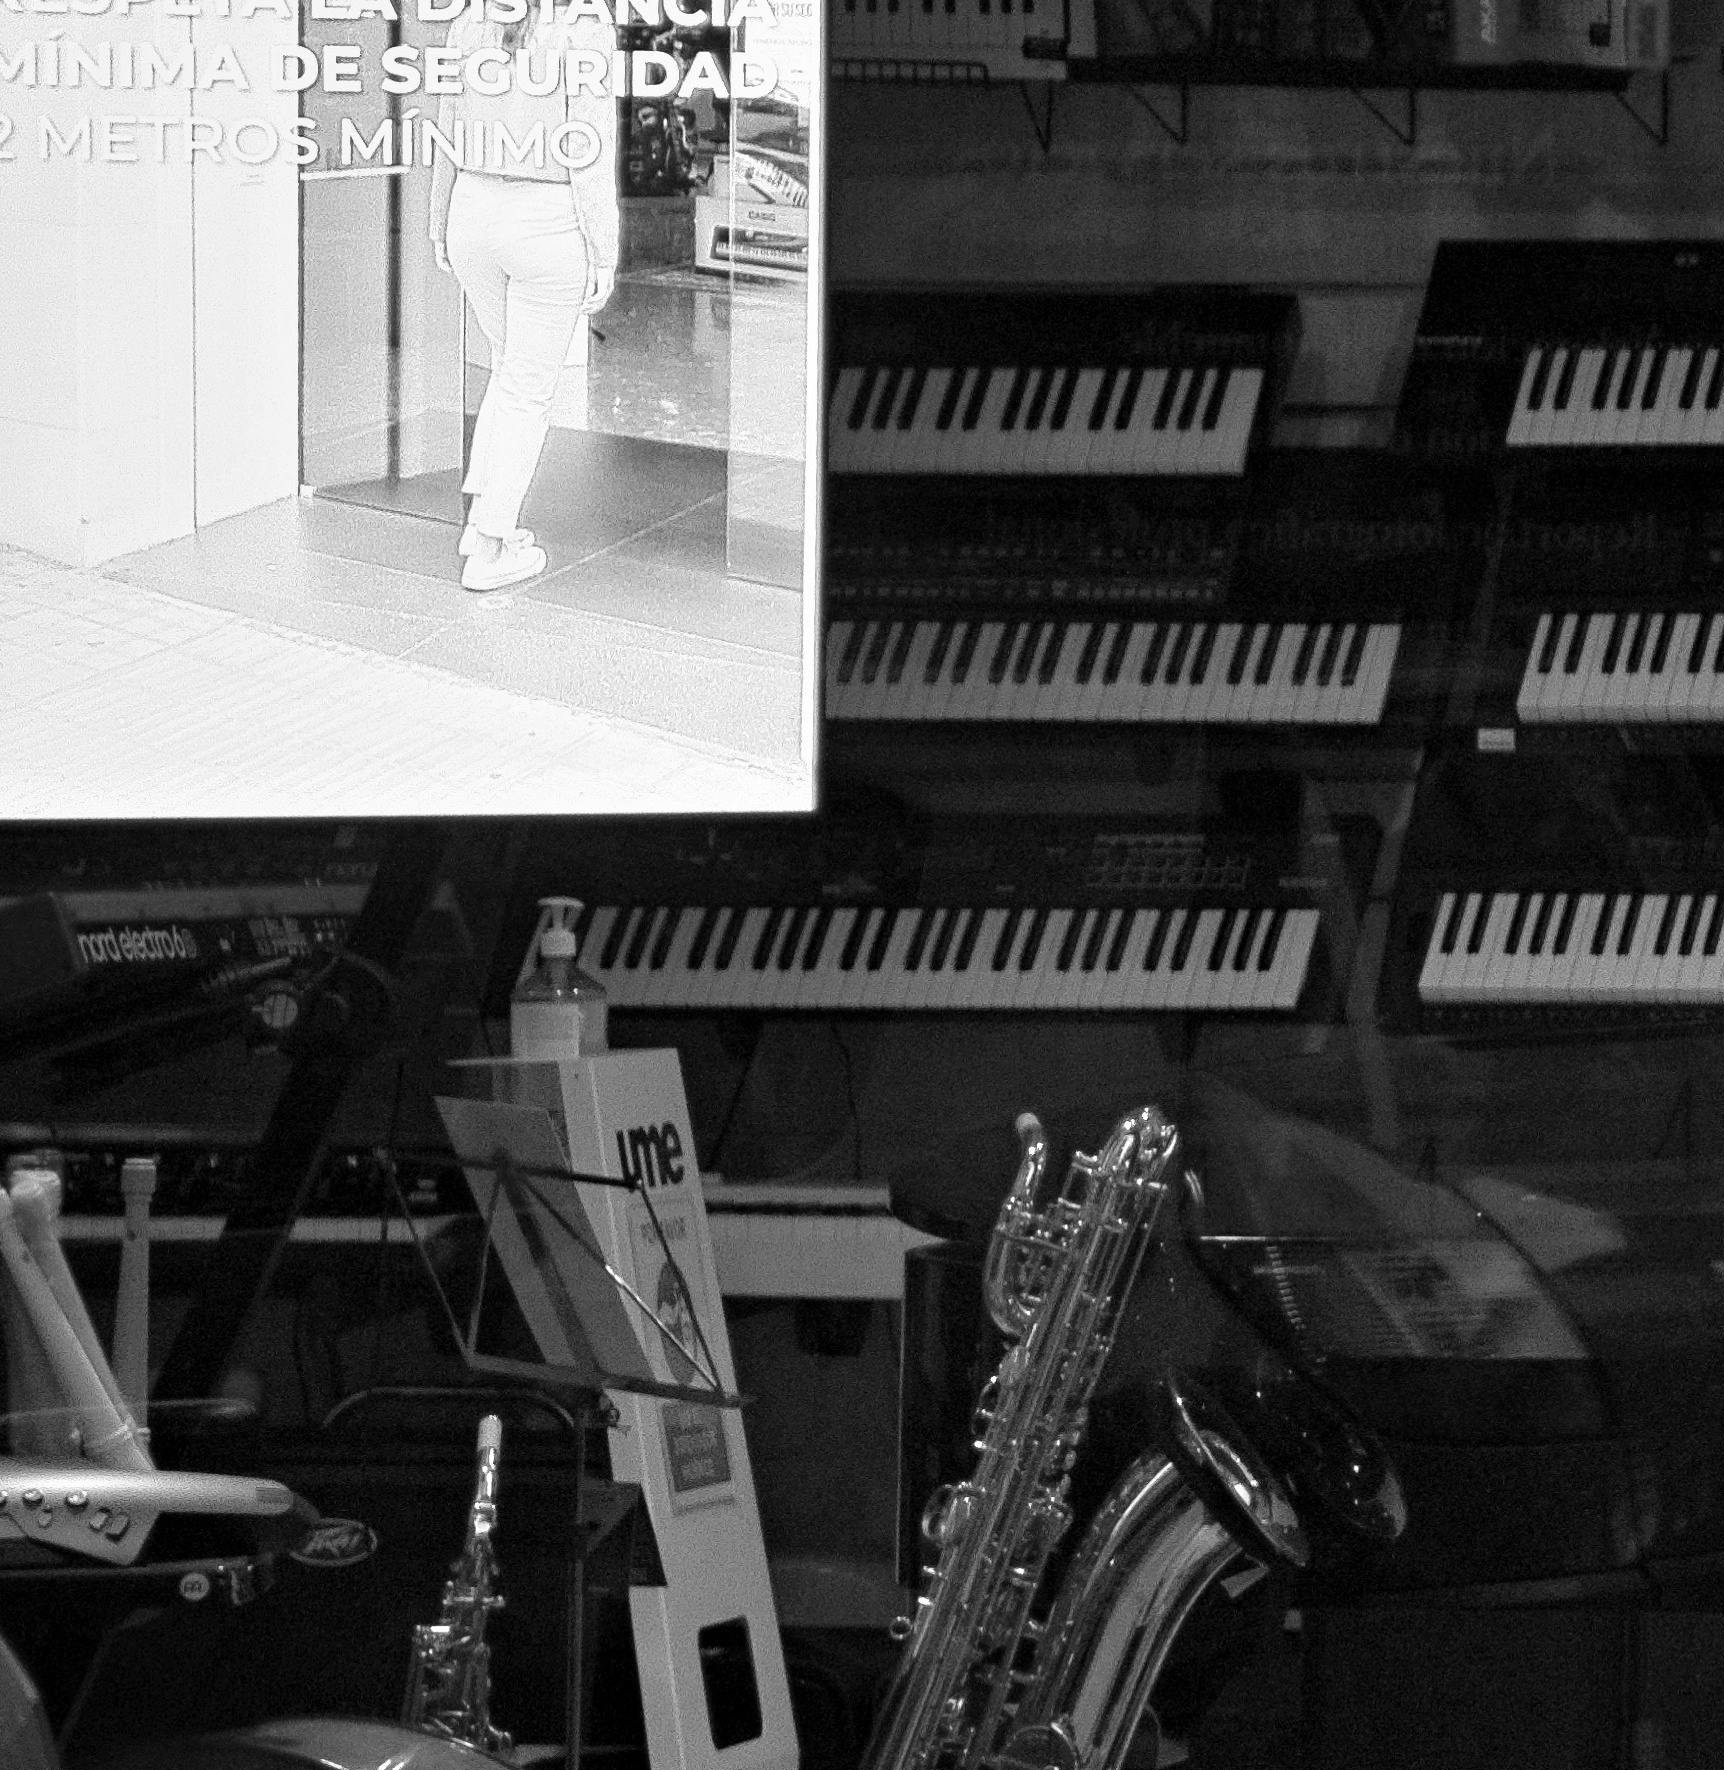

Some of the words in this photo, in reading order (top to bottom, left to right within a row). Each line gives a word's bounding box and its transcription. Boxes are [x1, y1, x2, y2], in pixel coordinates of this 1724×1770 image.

[272, 43, 365, 94] DE
[380, 42, 779, 99] SEGURIDAD
[38, 113, 320, 166] METROS
[341, 106, 602, 170] MÍNIMO
[77, 925, 121, 964] nord
